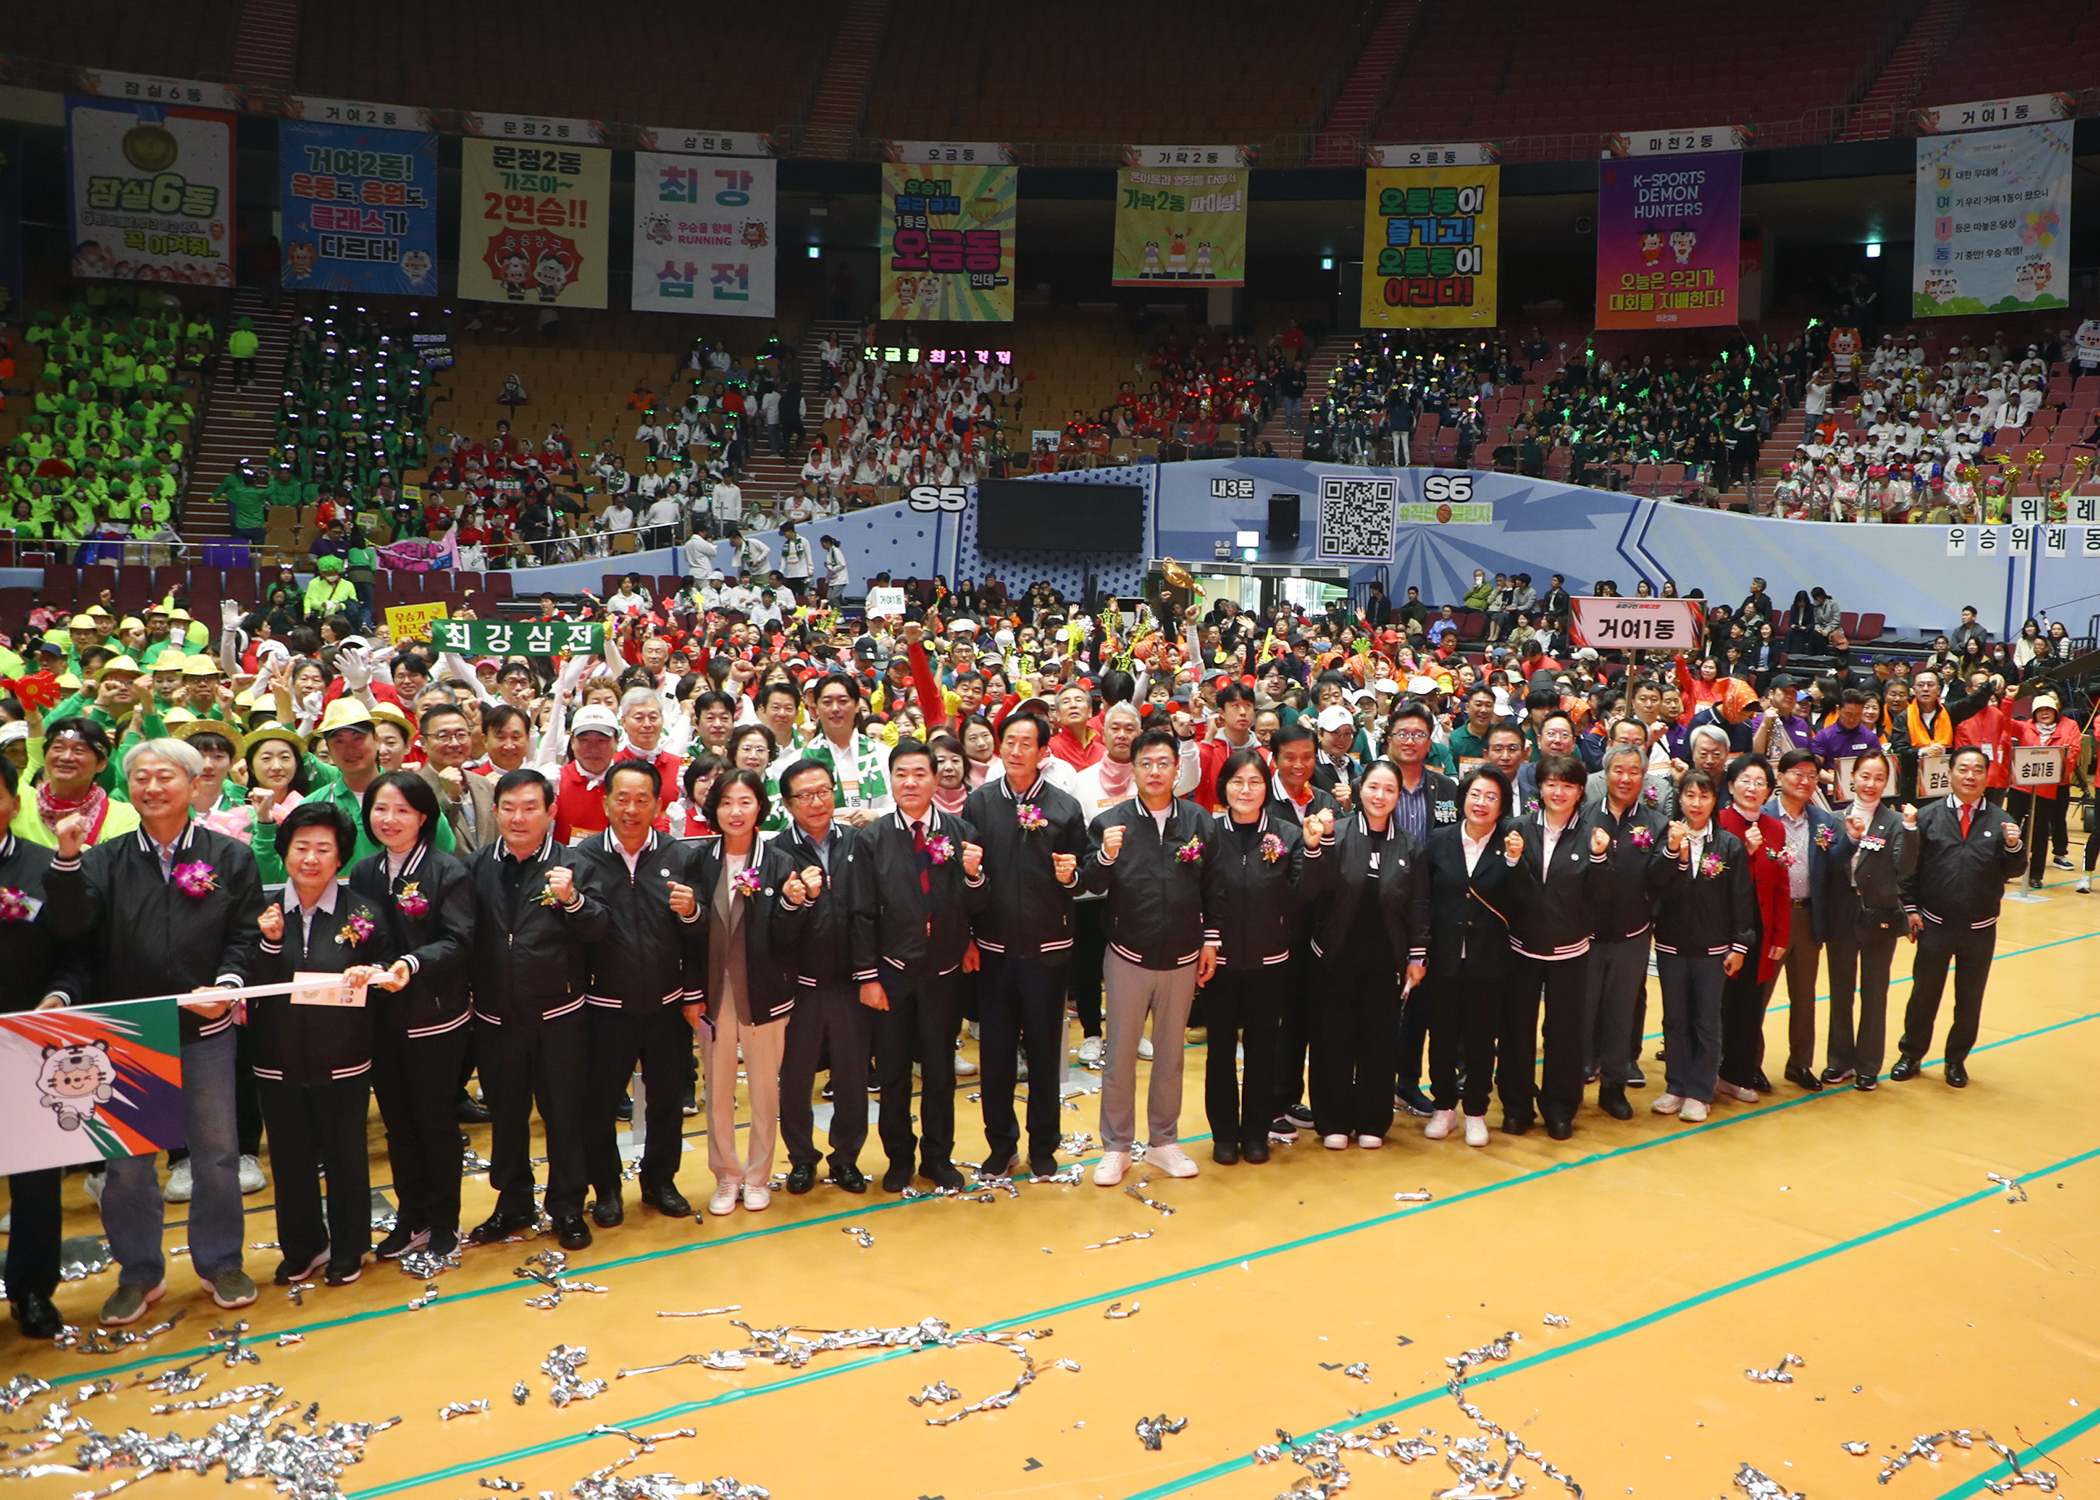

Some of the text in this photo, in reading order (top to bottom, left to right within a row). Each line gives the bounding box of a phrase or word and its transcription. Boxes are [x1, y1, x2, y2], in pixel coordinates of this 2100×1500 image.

[125, 81, 203, 103] 잠실6동
[326, 107, 397, 125] 거여2동
[1962, 105, 2030, 125] 거여1동
[504, 121, 570, 138] 문정2동
[684, 137, 733, 150] 삼전동
[1649, 135, 1713, 151] 마천2동
[305, 146, 413, 180] 거여2동!
[493, 145, 582, 175] 문정2동
[928, 149, 975, 161] 오금동
[1159, 152, 1219, 163] 가락2동
[500, 172, 574, 194] 가즈아~
[1633, 171, 1705, 188] K-SPORTS
[1939, 168, 1951, 180] 거
[89, 173, 218, 218] 잠실6동
[292, 173, 428, 209] 운동도, 응원도,
[659, 165, 754, 207] 최강
[906, 180, 951, 196] 우승기
[1639, 185, 1699, 203] DEMON
[484, 192, 587, 228] 2연승!!
[1123, 188, 1186, 212] 가락2동
[1380, 186, 1484, 215] 오륜동이
[1937, 196, 1950, 208] 여
[1984, 195, 2000, 204] 거여
[311, 205, 408, 235] 클래스가
[1634, 202, 1703, 219] HUNTERS
[678, 222, 733, 235] 우승을 향해
[896, 215, 927, 229] 1등은
[1388, 217, 1474, 245] 즐기고!
[1955, 223, 1971, 233] 등은
[1999, 218, 2017, 229] 당상
[319, 234, 399, 263] 다르다!
[505, 234, 562, 251] 승승장구
[678, 235, 732, 246] RUNNING
[892, 229, 1001, 271] 오금동
[1378, 246, 1482, 276] 오륜동이
[1936, 249, 1949, 261] 동
[1986, 248, 2002, 258] 우승
[656, 260, 749, 301] 삼전
[1621, 269, 1716, 291] 오늘은 우리가
[1384, 278, 1473, 306] 이긴다!
[1609, 289, 1725, 311] 대회를 지배한다!
[1211, 479, 1254, 499] 내3문
[1424, 475, 1473, 502] S6
[909, 486, 968, 512] S5
[395, 611, 425, 623] 우승기
[444, 623, 593, 652] 최강삼전
[1598, 619, 1675, 640] 거여1동
[2021, 762, 2054, 778] 송파1동
[1930, 772, 1950, 789] 잠실
